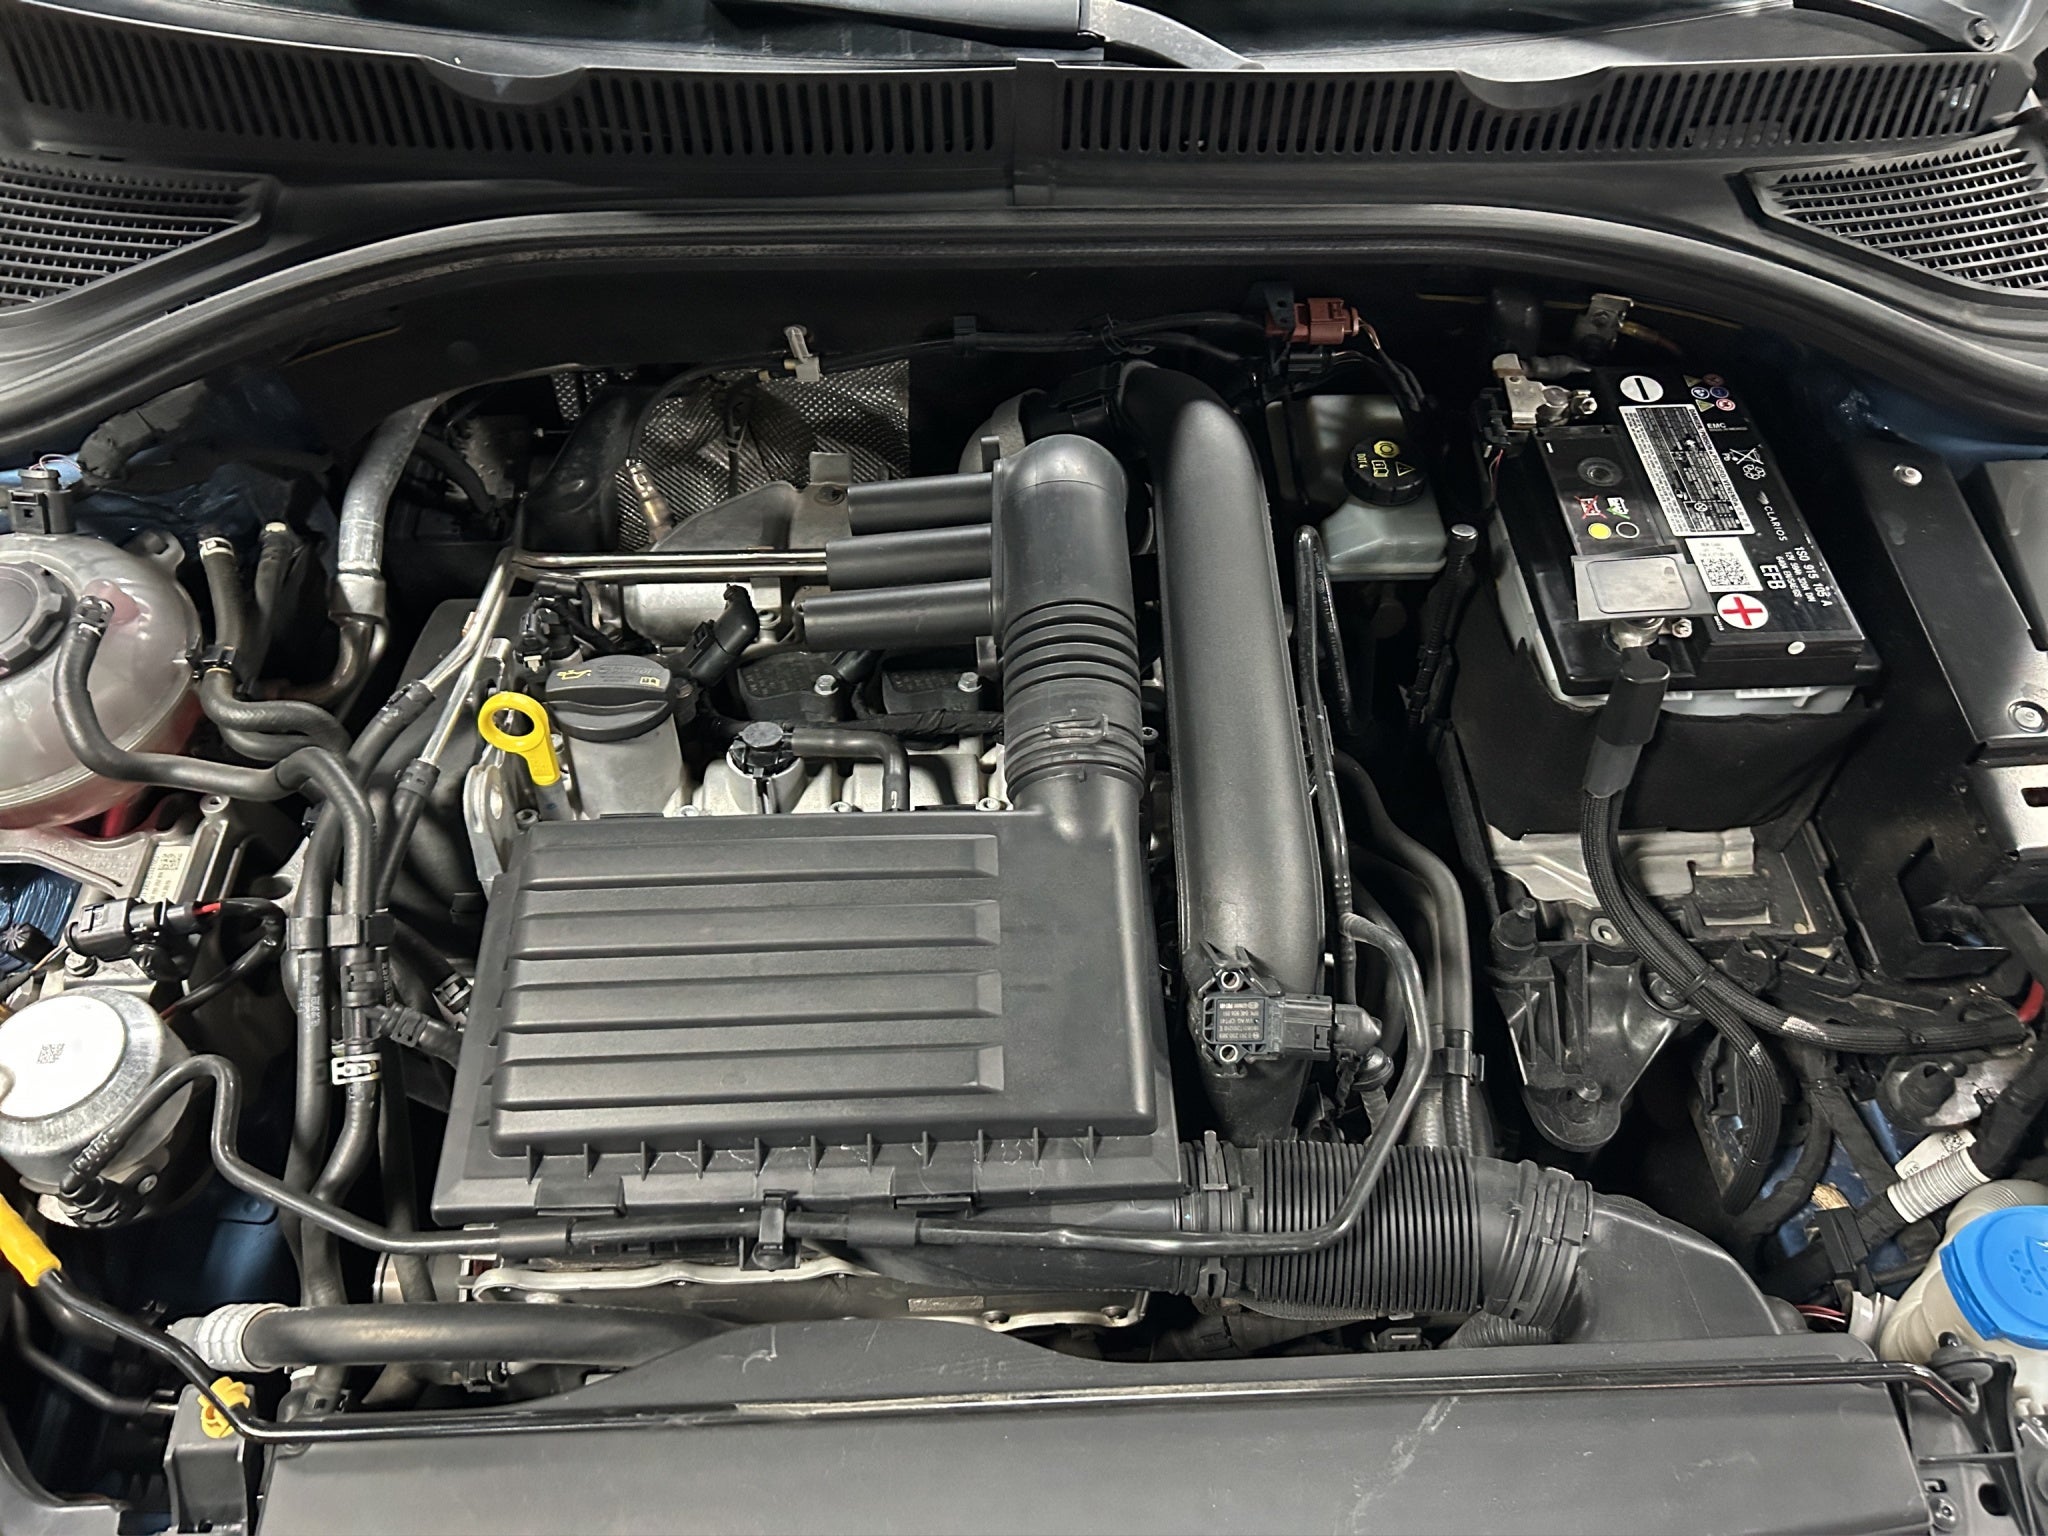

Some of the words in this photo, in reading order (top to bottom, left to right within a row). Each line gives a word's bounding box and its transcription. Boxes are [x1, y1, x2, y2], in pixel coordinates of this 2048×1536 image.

[1764, 505, 1788, 542] CLARIOS
[1785, 551, 1796, 561] 12V
[1760, 564, 1787, 590] EFB
[1803, 564, 1819, 579] 915
[1820, 599, 1833, 607] A
